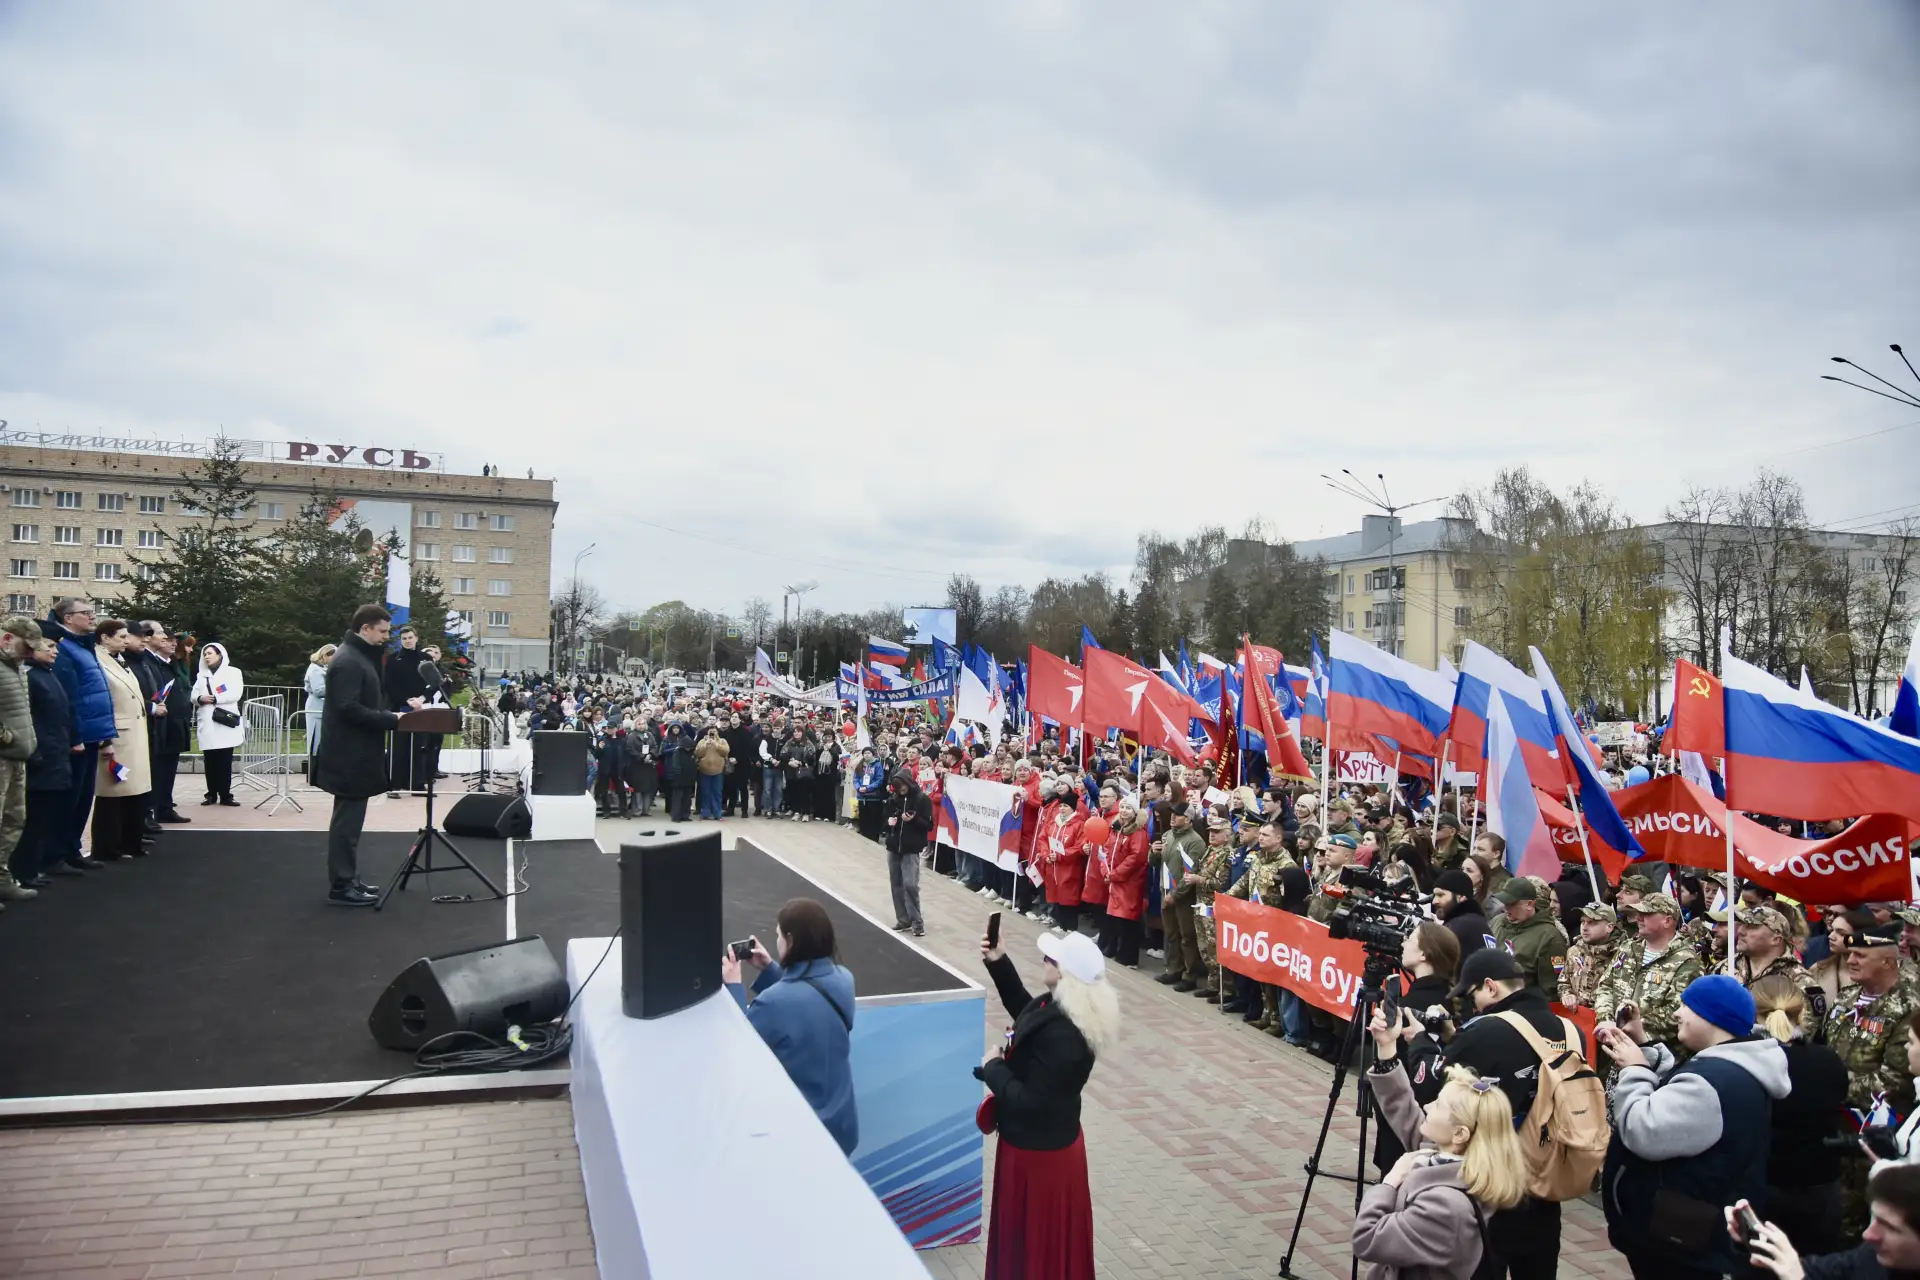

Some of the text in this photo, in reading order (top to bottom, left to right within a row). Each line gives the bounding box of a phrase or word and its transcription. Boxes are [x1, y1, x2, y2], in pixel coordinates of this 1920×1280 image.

[286, 441, 432, 470] РУСЬ
[839, 682, 886, 700] ВМСТЕ
[912, 678, 949, 697] СИЛА!
[1222, 920, 1313, 983] Победа
